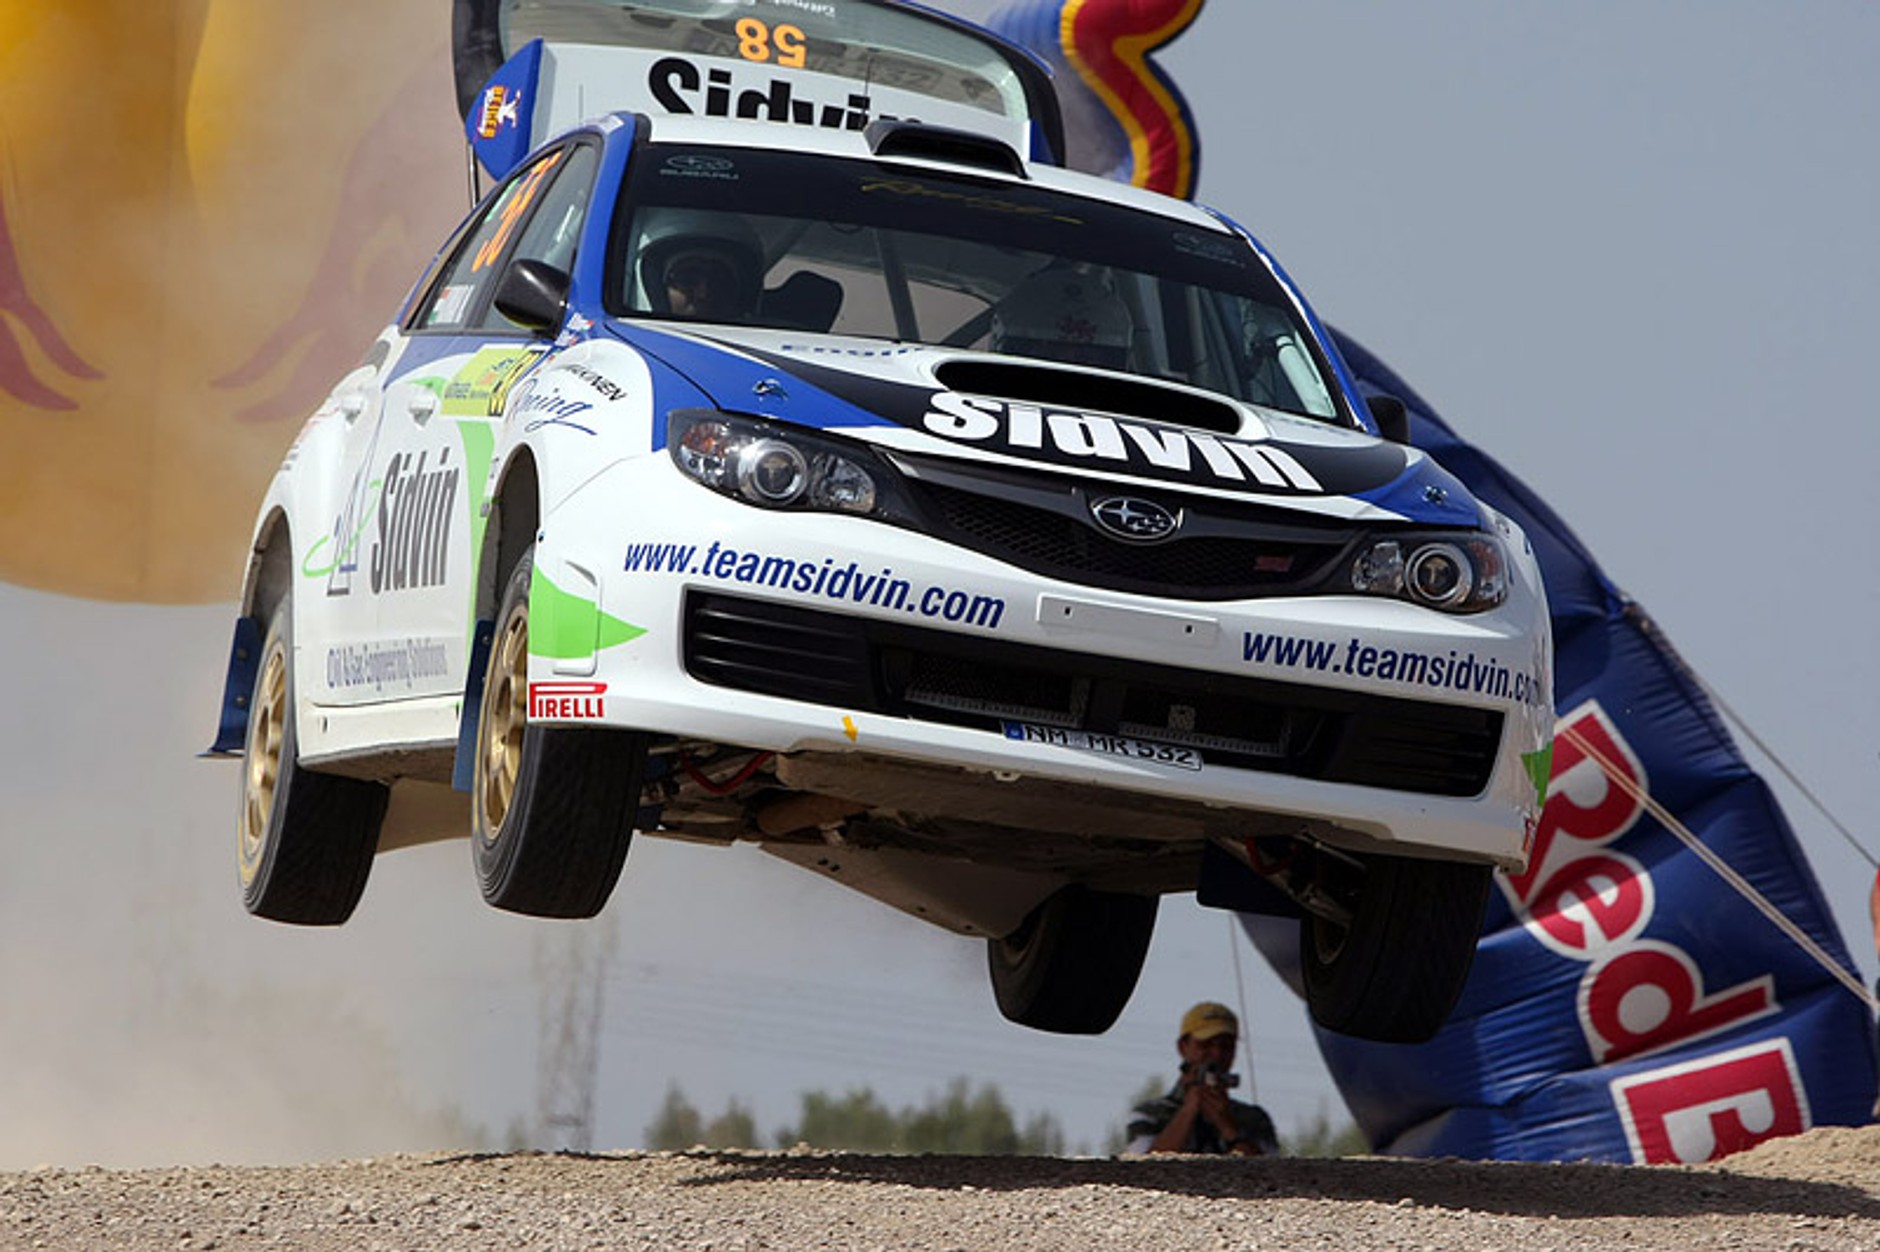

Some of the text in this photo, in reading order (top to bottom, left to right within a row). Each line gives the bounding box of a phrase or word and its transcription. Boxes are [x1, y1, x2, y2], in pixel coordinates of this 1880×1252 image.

[735, 18, 807, 68] 58
[923, 391, 1324, 491] Sidvin
[371, 446, 459, 595] Sidvin
[623, 541, 1005, 628] www.teamsidvin.com
[529, 681, 608, 717] PIRELLI
[1025, 725, 1068, 745] NM
[1087, 734, 1131, 755] MR
[1497, 704, 1779, 1064] Red
